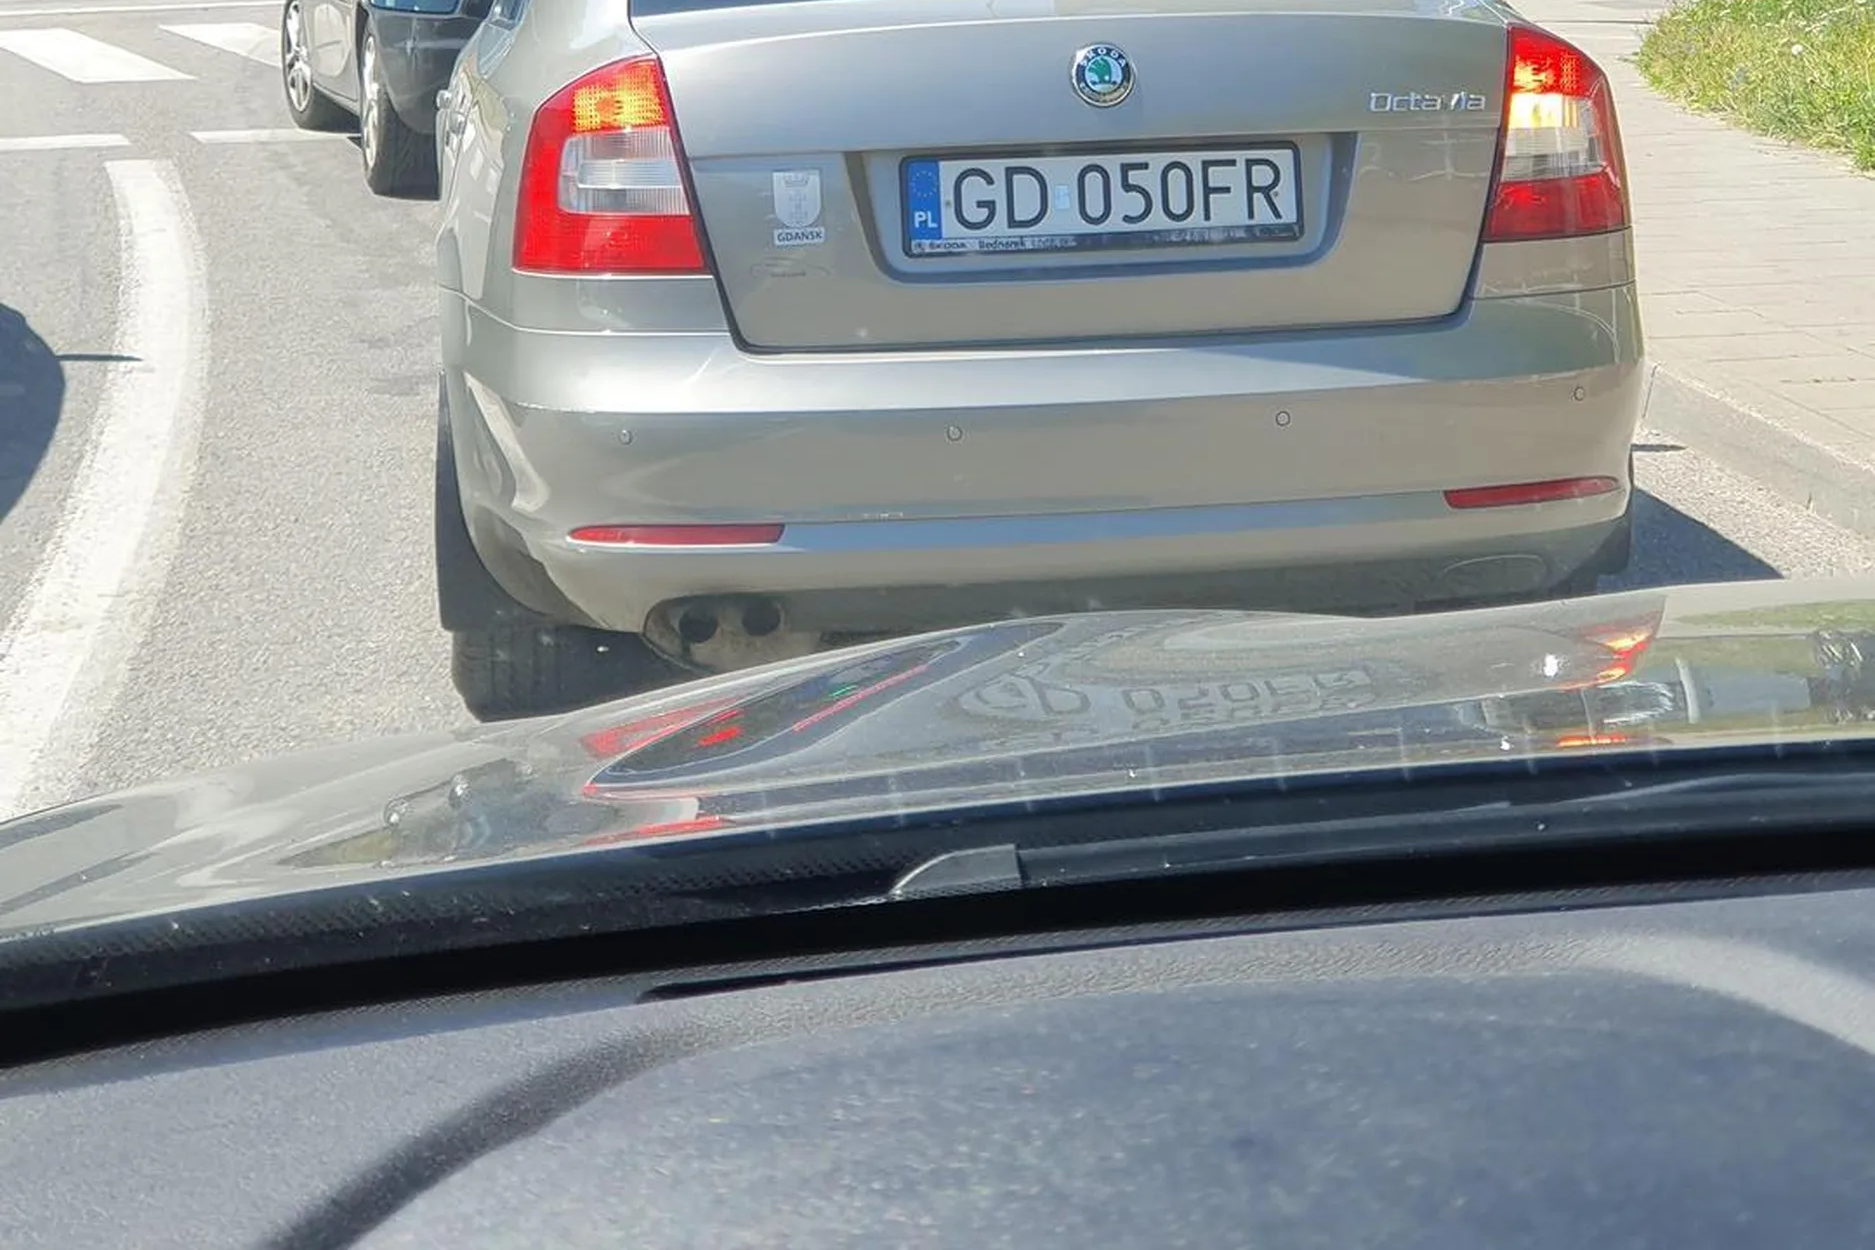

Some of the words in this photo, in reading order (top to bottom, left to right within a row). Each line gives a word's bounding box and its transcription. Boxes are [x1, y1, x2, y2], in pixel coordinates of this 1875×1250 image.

[1370, 91, 1486, 111] Octavia
[953, 166, 1049, 231] GD
[1076, 157, 1283, 226] 050FR
[913, 210, 938, 229] PL
